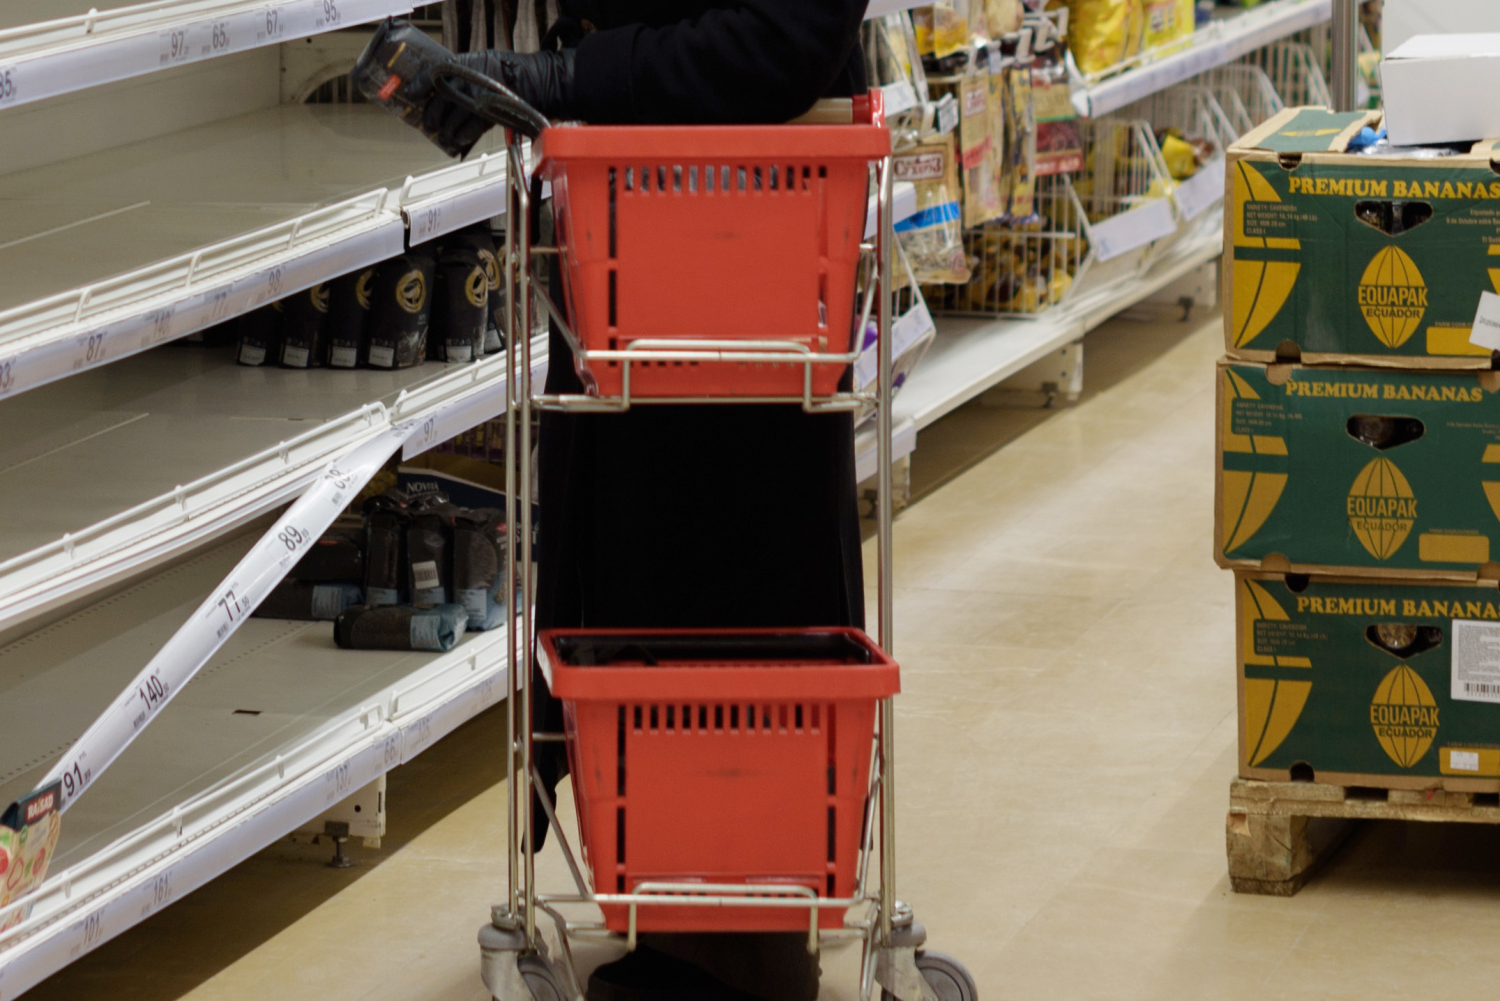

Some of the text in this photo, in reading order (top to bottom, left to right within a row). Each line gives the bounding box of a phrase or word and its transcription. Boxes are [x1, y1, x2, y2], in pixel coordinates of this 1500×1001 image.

[266, 9, 278, 35] 67
[324, 0, 337, 23] 95
[171, 31, 184, 57] 97
[213, 23, 226, 48] 65
[1289, 177, 1500, 199] PREMIUM BANANAS
[427, 208, 437, 233] 91
[268, 270, 282, 294] 98
[1358, 285, 1428, 307] EQUAPAK
[1366, 307, 1420, 318] ECUADOR
[86, 333, 103, 361] 87
[1285, 380, 1483, 403] PREMIUM BANANAS
[423, 417, 434, 442] 97
[406, 481, 440, 494] NOVITA
[1347, 496, 1418, 518] EQUAPAK
[278, 525, 303, 551] 89
[1357, 521, 1407, 532] ECUADOR
[218, 589, 241, 622] 77
[1296, 596, 1500, 619] PREMIUM BANANA
[139, 675, 164, 710] 140
[1370, 705, 1440, 727] EQUAPAK
[1378, 727, 1433, 738] ECUADOR
[384, 737, 396, 764] 66
[63, 761, 83, 797] 91
[154, 876, 170, 904] 161
[82, 916, 100, 947] 101
